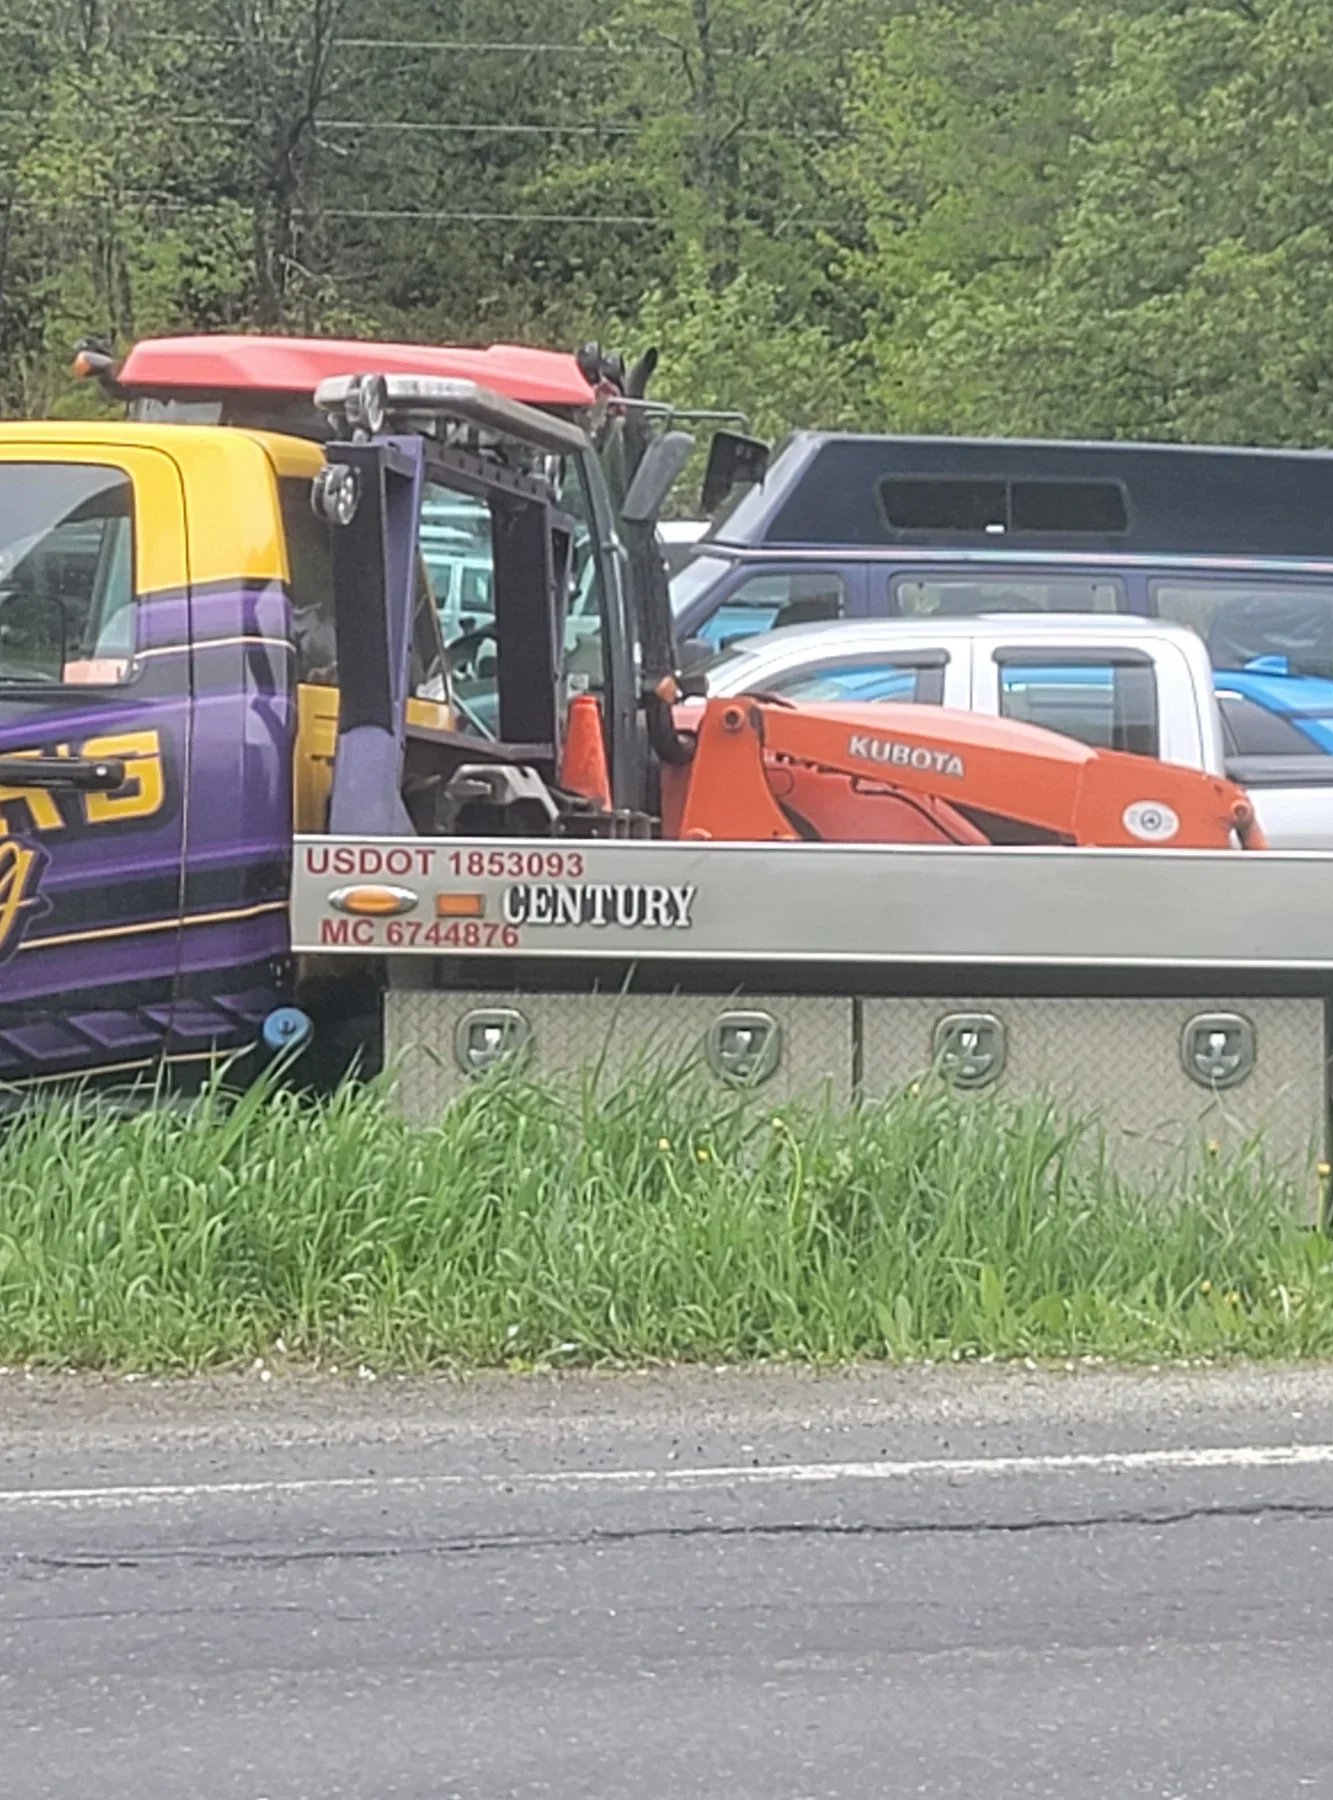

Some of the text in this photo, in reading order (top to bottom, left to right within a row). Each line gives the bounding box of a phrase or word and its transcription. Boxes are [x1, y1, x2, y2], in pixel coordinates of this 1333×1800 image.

[849, 735, 965, 777] KUBOTA
[306, 848, 584, 877] USDOT 1853093
[503, 883, 697, 928] CENTURY
[321, 919, 519, 948] MC 6744876
